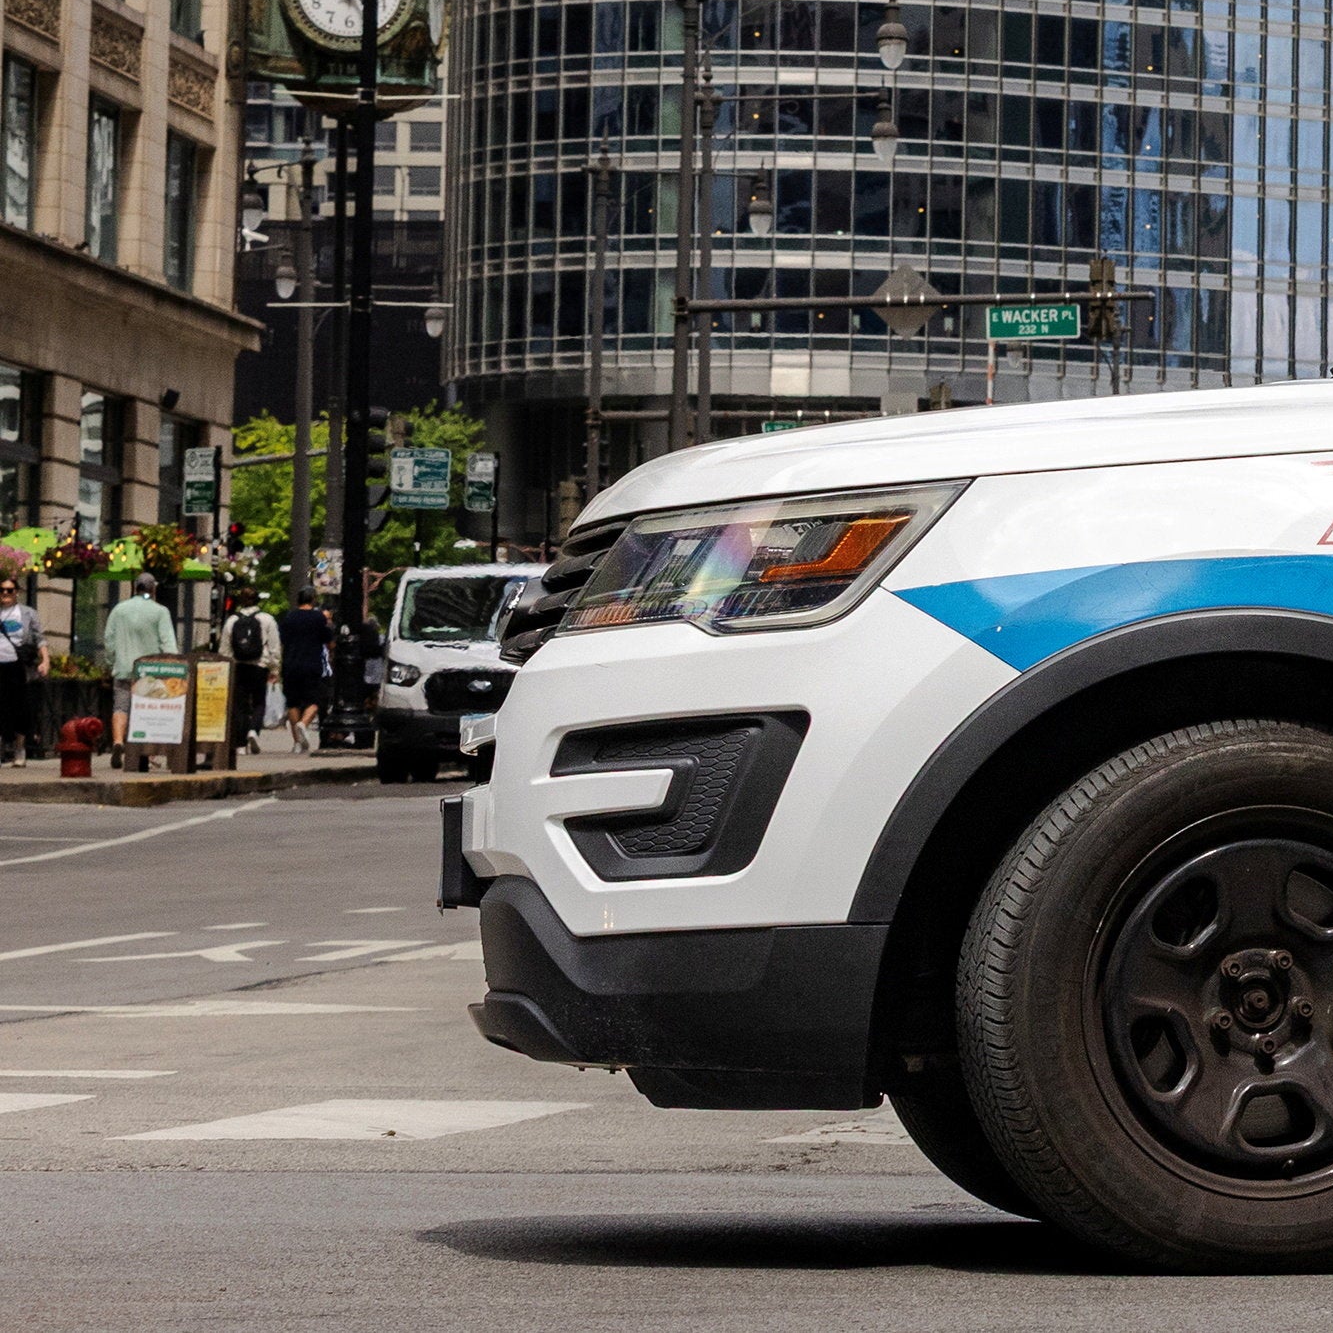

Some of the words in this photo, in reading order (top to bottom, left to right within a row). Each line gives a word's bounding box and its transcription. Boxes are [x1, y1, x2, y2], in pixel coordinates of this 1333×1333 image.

[326, 11, 335, 24] 7
[345, 16, 355, 28] 6
[992, 312, 999, 323] E
[1001, 308, 1059, 324] WACKER
[1061, 310, 1075, 321] PL
[1018, 324, 1037, 335] 232
[1041, 324, 1049, 334] N
